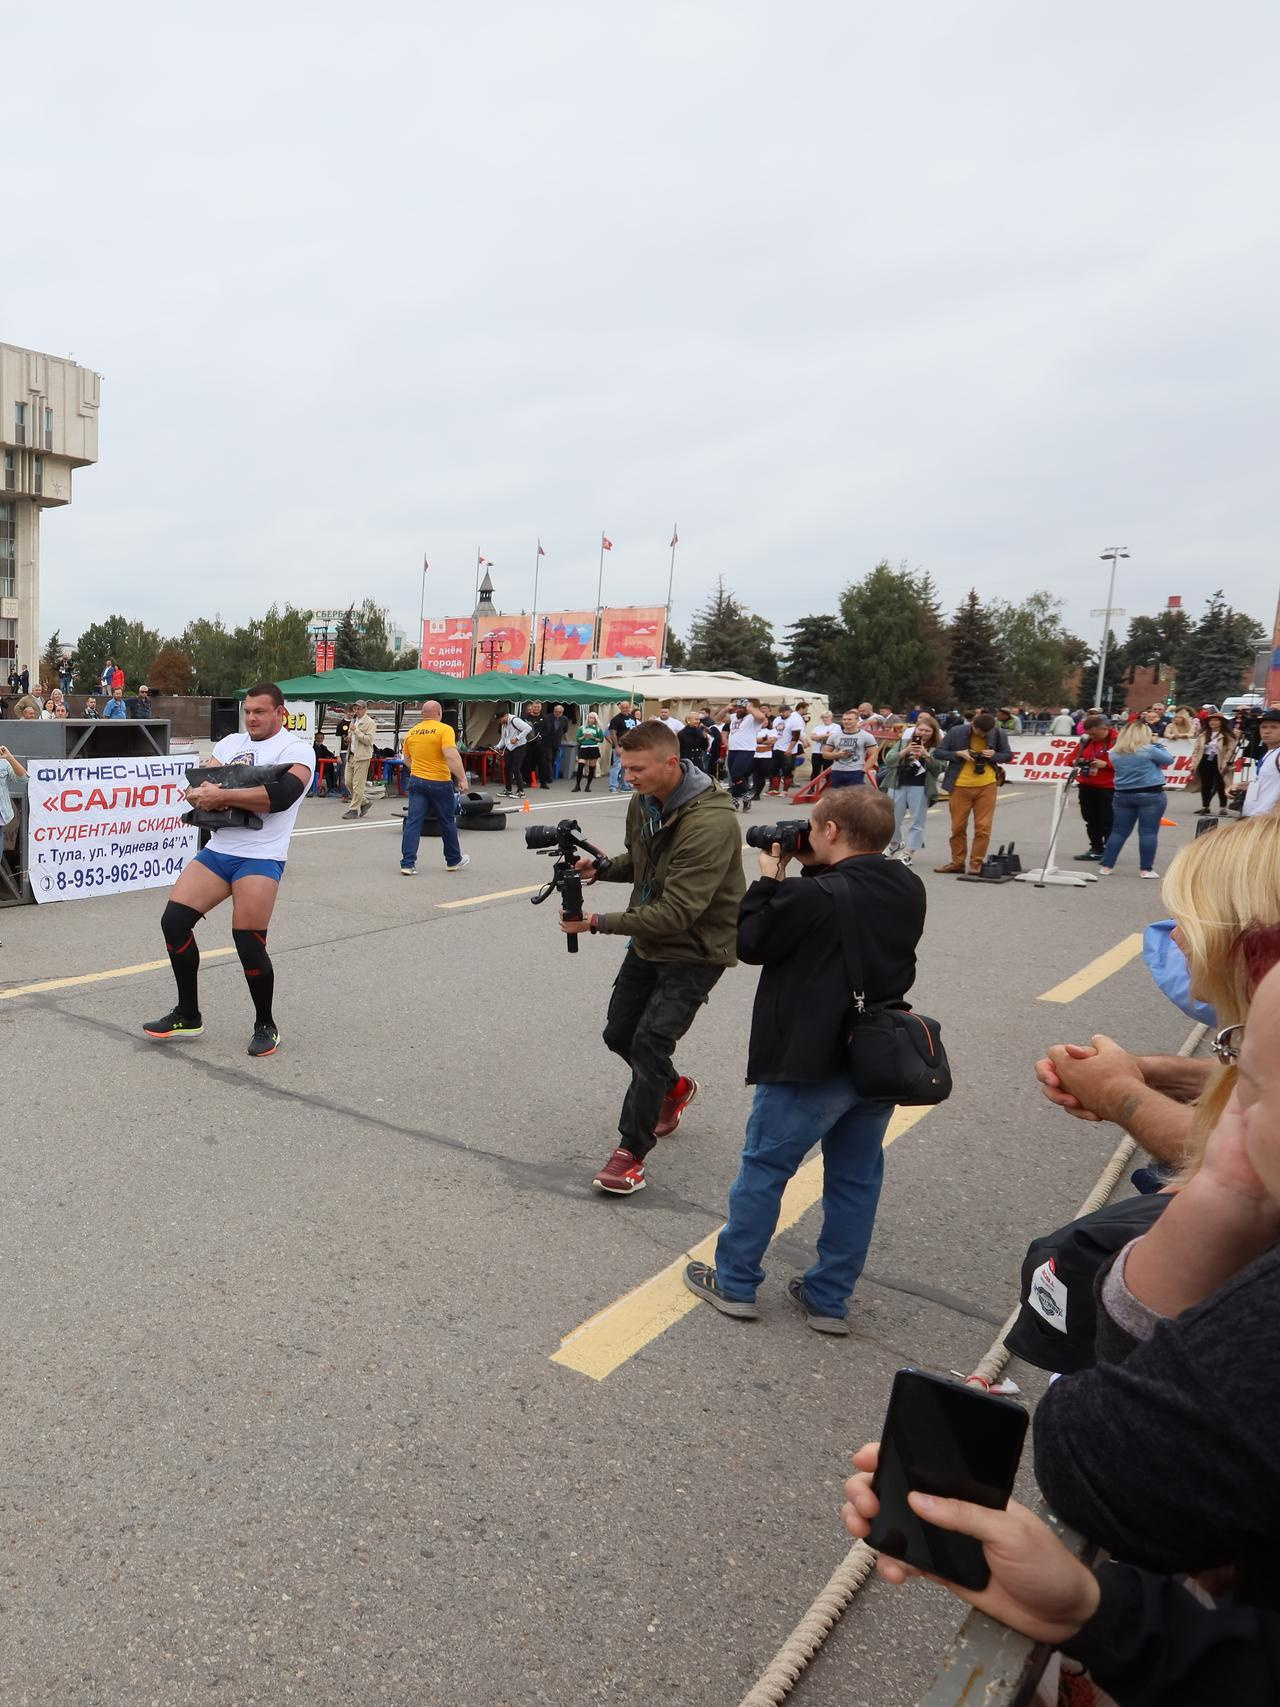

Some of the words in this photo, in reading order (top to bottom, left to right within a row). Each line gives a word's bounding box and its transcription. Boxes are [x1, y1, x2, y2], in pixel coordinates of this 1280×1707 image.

[429, 647, 436, 655] С
[438, 645, 463, 656] днём
[428, 659, 465, 669] города,
[410, 728, 437, 736] СУДЬЯ
[42, 784, 187, 812] «САЛЮТ»
[33, 821, 132, 842] СТУДЕНТАМ
[38, 853, 46, 864] г.
[50, 849, 86, 866] Тула,
[89, 847, 107, 862] ул.
[111, 840, 159, 858] Руднева
[56, 857, 184, 891] 8-953-962-90-04
